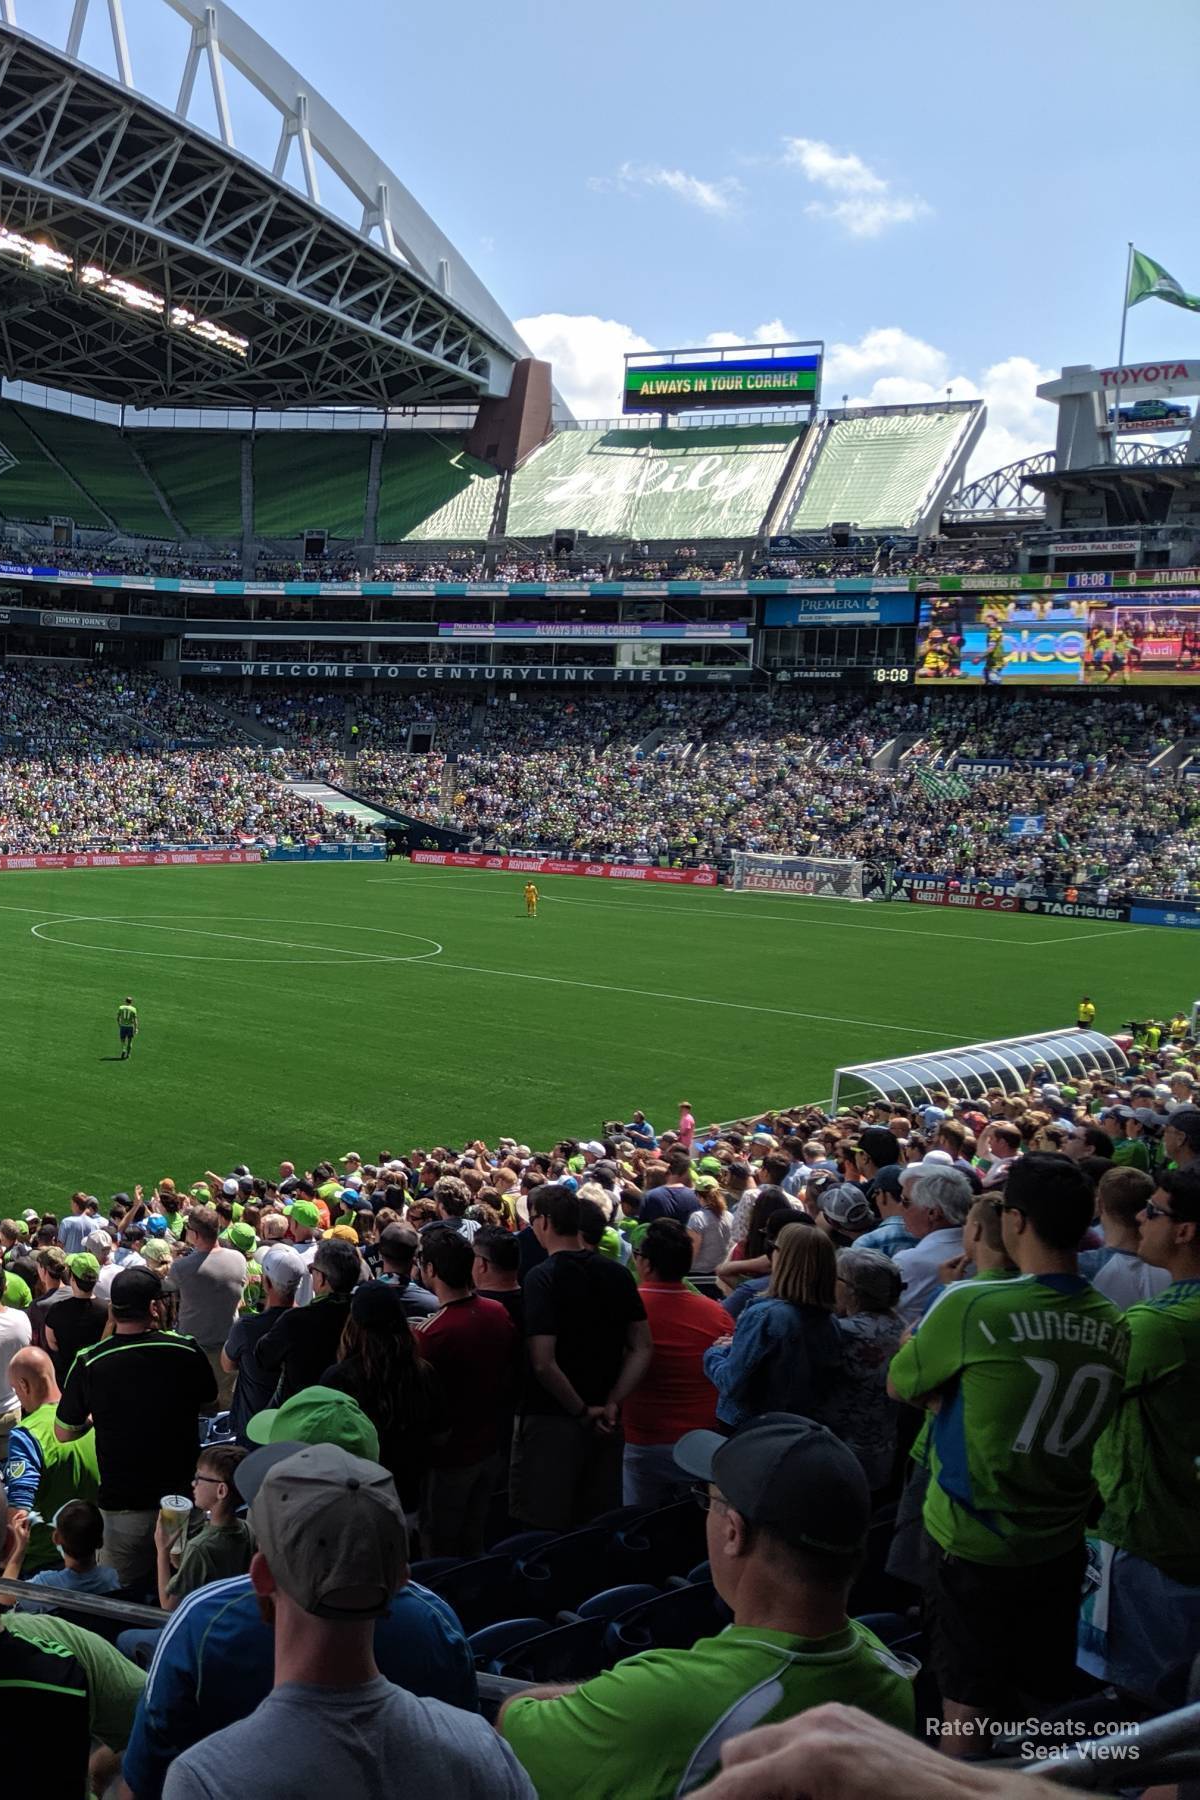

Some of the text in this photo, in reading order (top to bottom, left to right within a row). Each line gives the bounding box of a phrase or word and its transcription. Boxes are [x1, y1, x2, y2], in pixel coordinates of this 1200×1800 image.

[1100, 363, 1189, 386] TOYOTA
[640, 372, 798, 395] ALWAYS IN YOUR CORNER
[1117, 418, 1175, 429] TUNDRA
[1112, 542, 1136, 550] DECK
[58, 569, 86, 578] PREMERA
[1075, 572, 1105, 586] 18:08
[1129, 570, 1195, 585] 0 ATLANTA
[961, 576, 1008, 589] SOUNDERS
[1010, 575, 1022, 588] FC
[800, 599, 860, 611] PREMERA
[56, 616, 106, 627] JIMMY JOHN'S
[536, 625, 642, 636] ALWAYS IN YOUR CORNER
[1142, 645, 1172, 655] Audi
[241, 664, 687, 681] WELCOME TO CENTURYLINK FIELD
[415, 853, 446, 864] REHYDRATE
[508, 859, 543, 871] REHYDRATE
[772, 878, 814, 891] FARGO
[1011, 1356, 1112, 1457] 10
